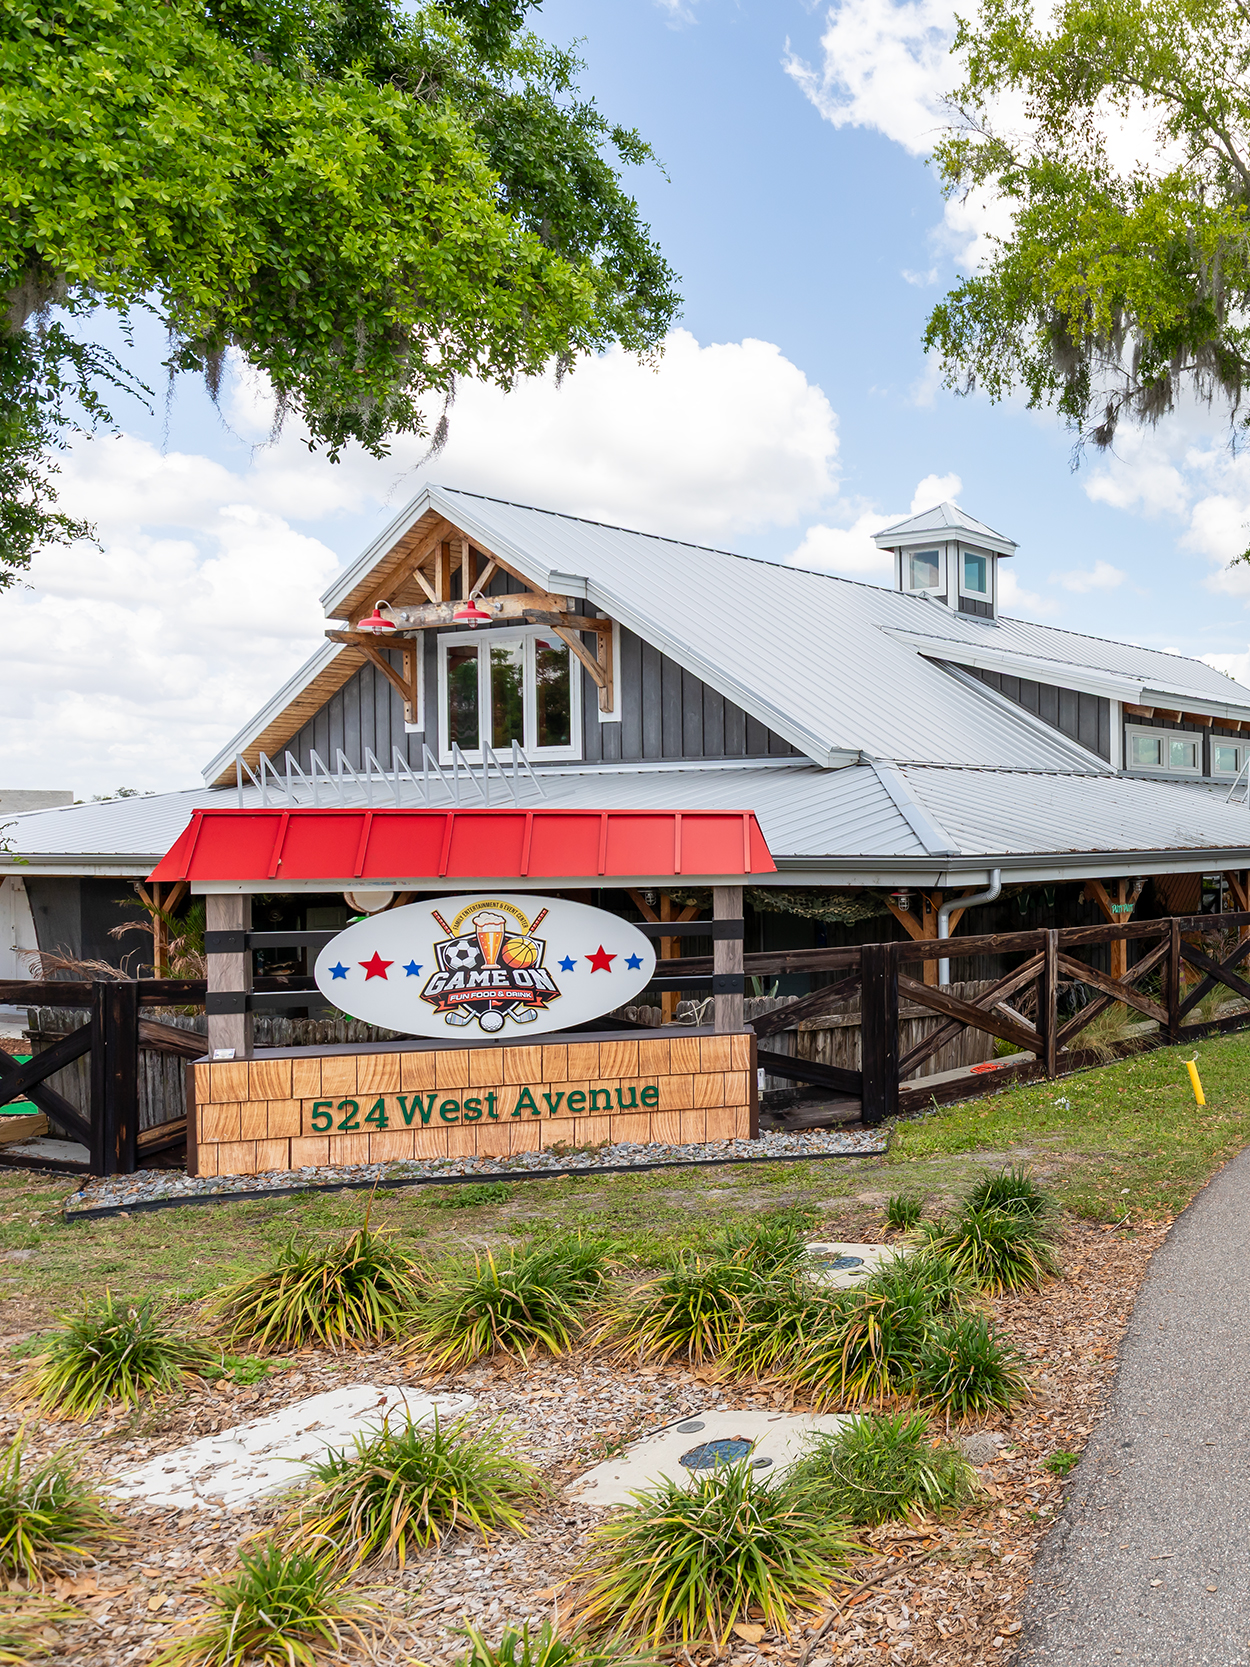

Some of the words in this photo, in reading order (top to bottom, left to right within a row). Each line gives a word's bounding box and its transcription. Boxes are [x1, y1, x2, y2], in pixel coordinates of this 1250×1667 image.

[453, 914, 463, 930] FAMILY
[462, 902, 499, 917] ENTERTAINMENT
[503, 904, 518, 914] EVENT
[515, 911, 529, 928] CENTER
[423, 969, 510, 996] GAME
[512, 968, 556, 991] ON
[449, 992, 470, 1001] FUN
[470, 991, 496, 999] FOOD
[311, 1098, 389, 1132] 524
[396, 1091, 499, 1126] West
[511, 1084, 660, 1117] Avenue
